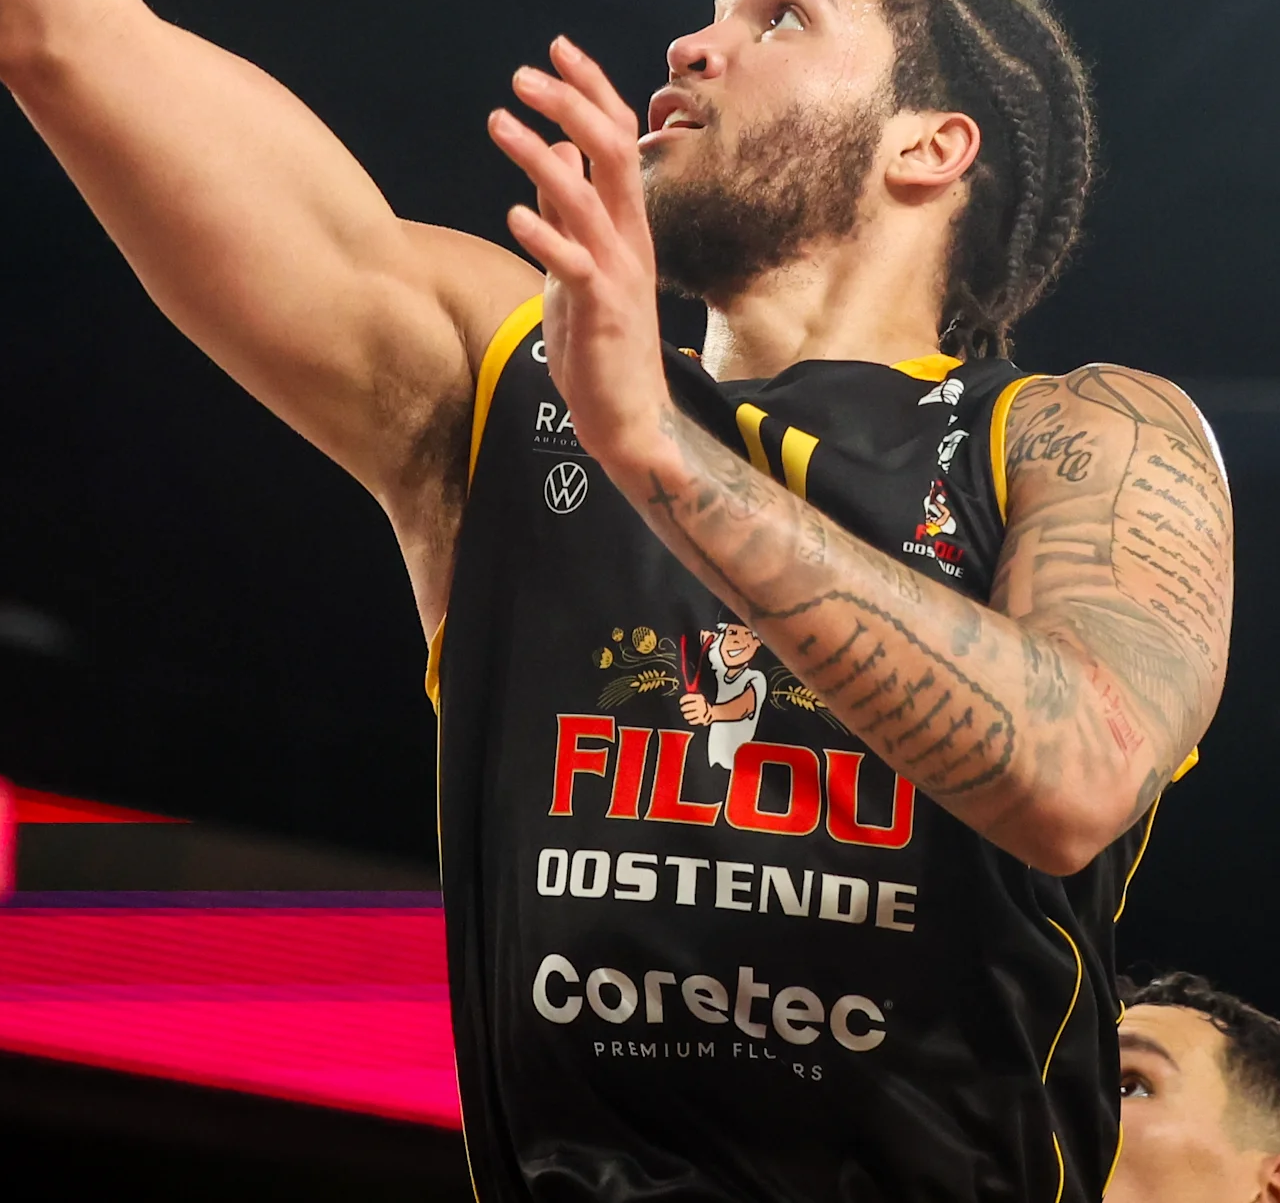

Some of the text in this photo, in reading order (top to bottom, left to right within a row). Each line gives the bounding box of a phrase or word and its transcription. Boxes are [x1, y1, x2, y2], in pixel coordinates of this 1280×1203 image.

[548, 713, 916, 850] FILOU
[536, 848, 918, 932] OOSTENDE
[594, 1041, 716, 1059] PREMIUM
